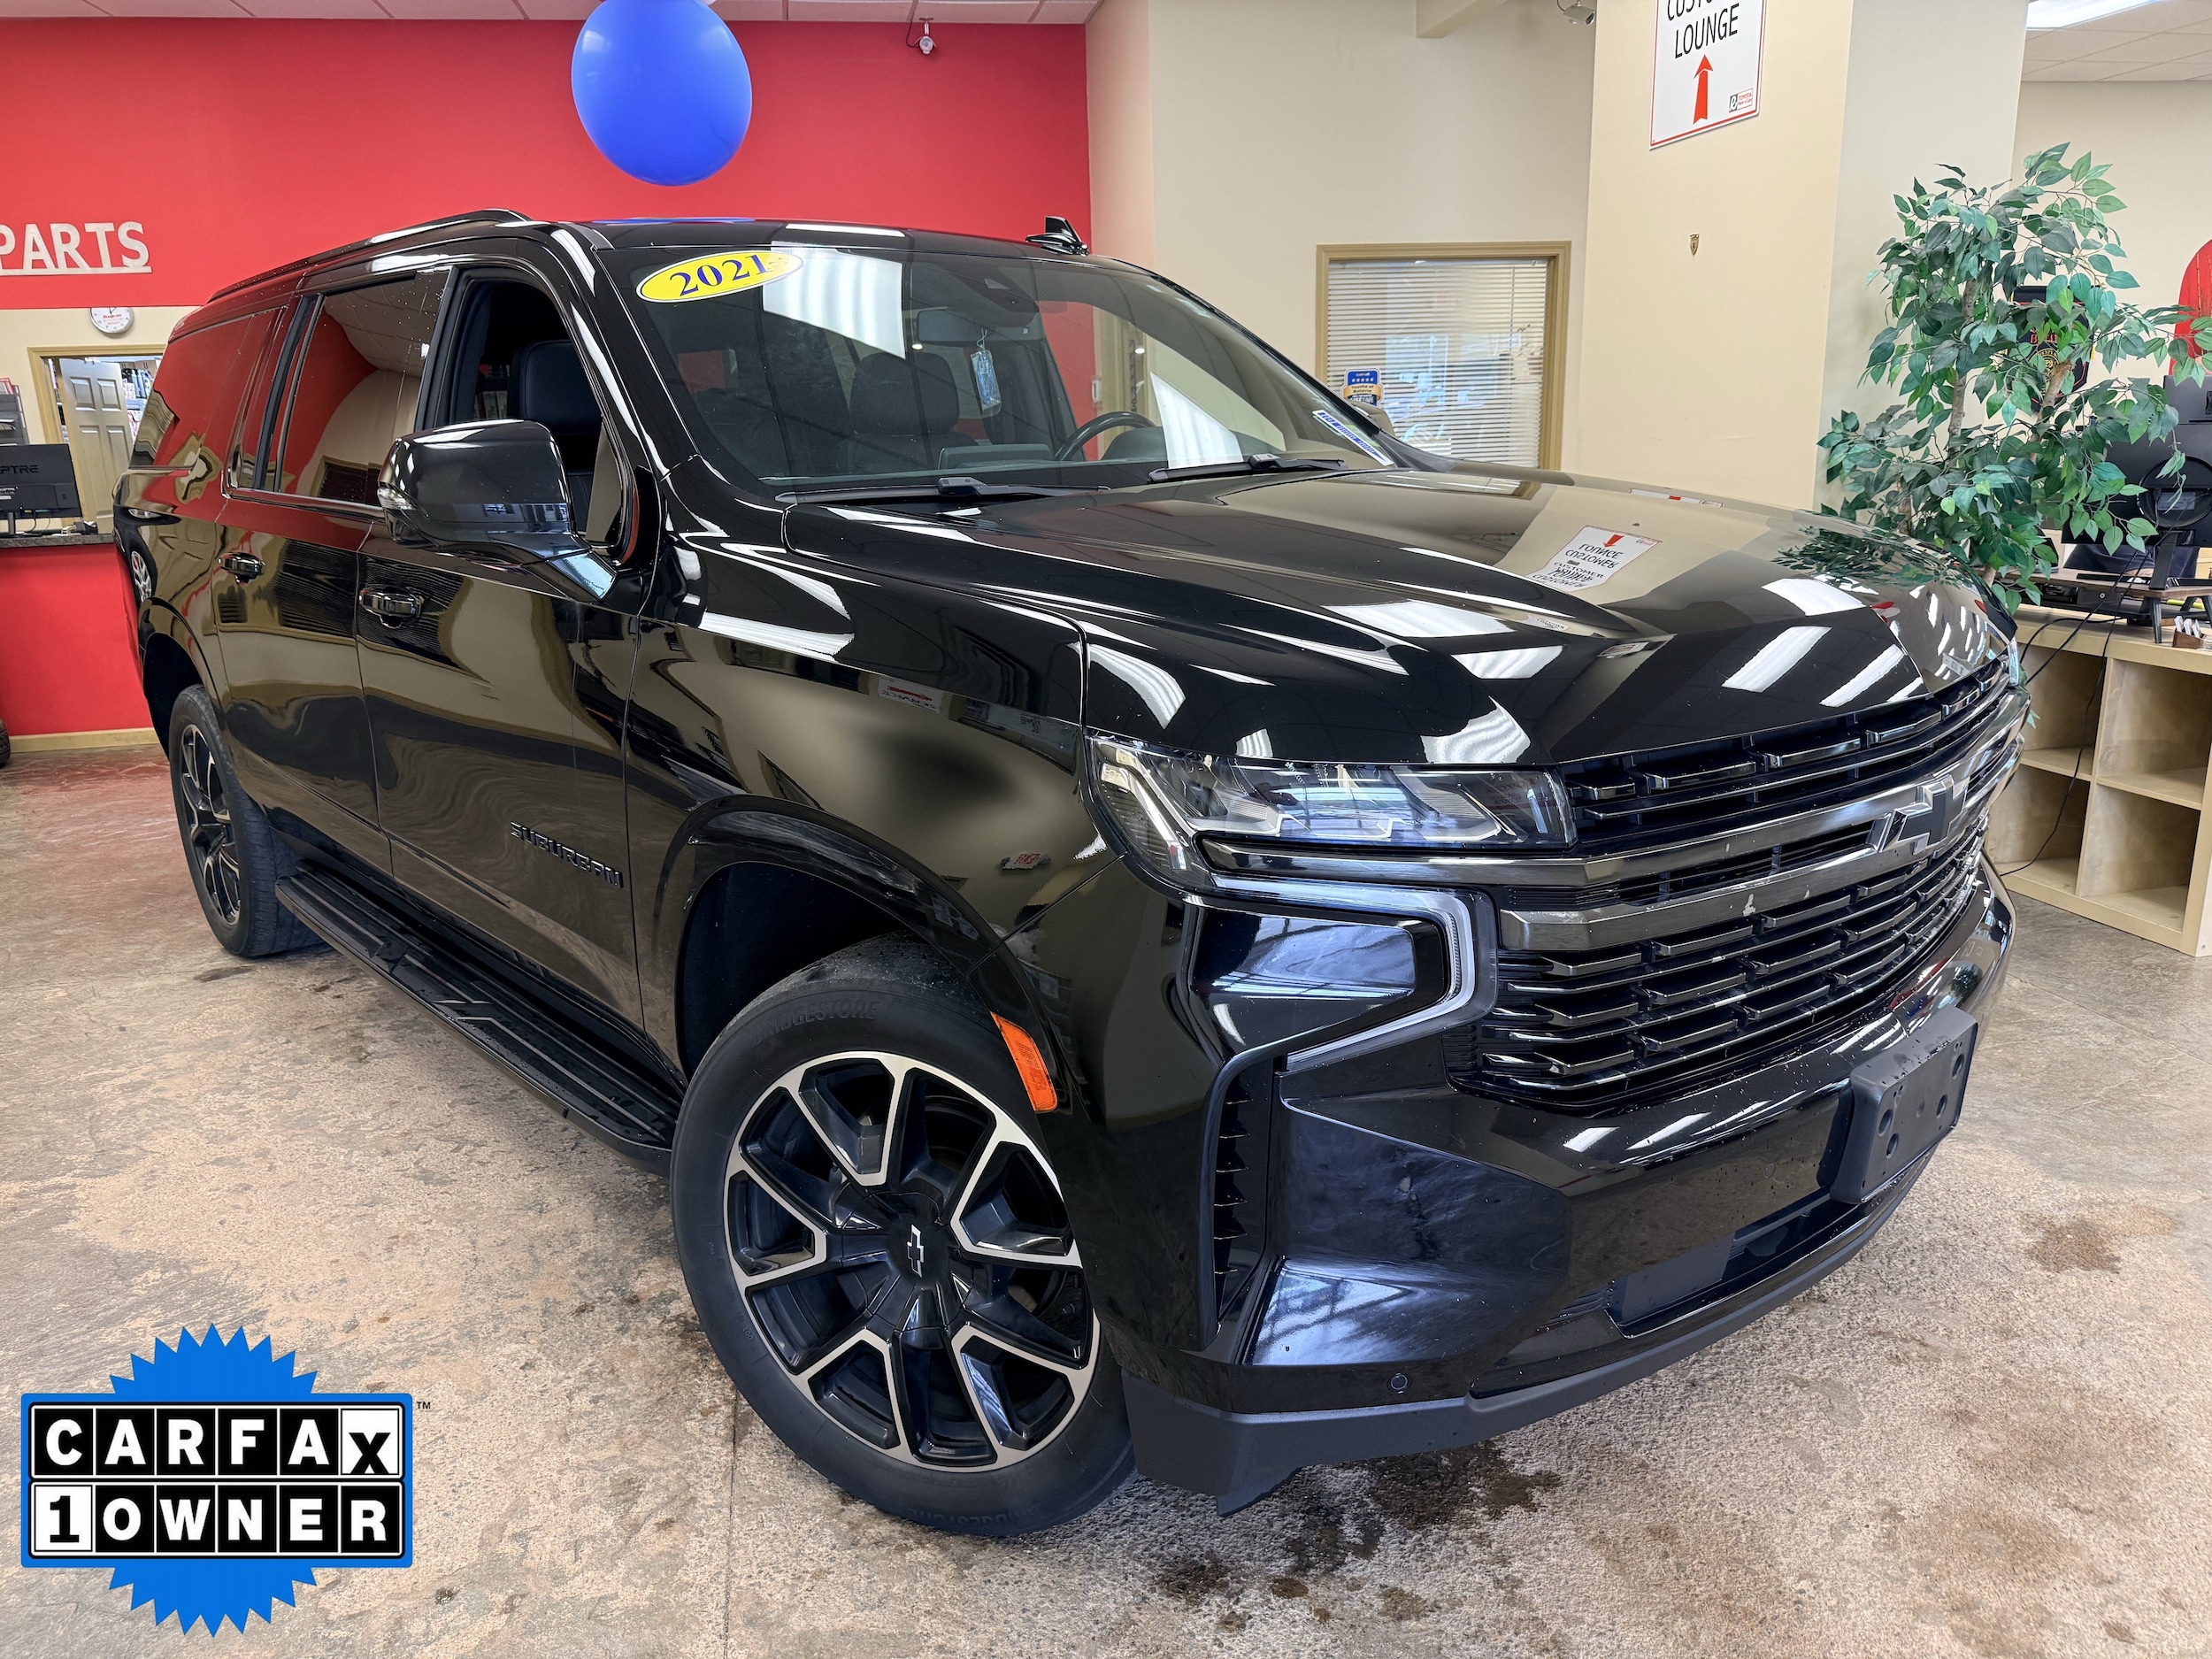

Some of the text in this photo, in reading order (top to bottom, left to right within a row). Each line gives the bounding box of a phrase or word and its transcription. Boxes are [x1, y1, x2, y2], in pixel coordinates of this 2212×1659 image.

[1675, 3, 1740, 59] LOUNGE
[0, 221, 150, 269] PARTS
[670, 254, 773, 296] 2021
[0, 465, 39, 474] PTRE
[511, 821, 624, 888] SUBURBAN
[752, 999, 880, 1048] BRIDGESTONE
